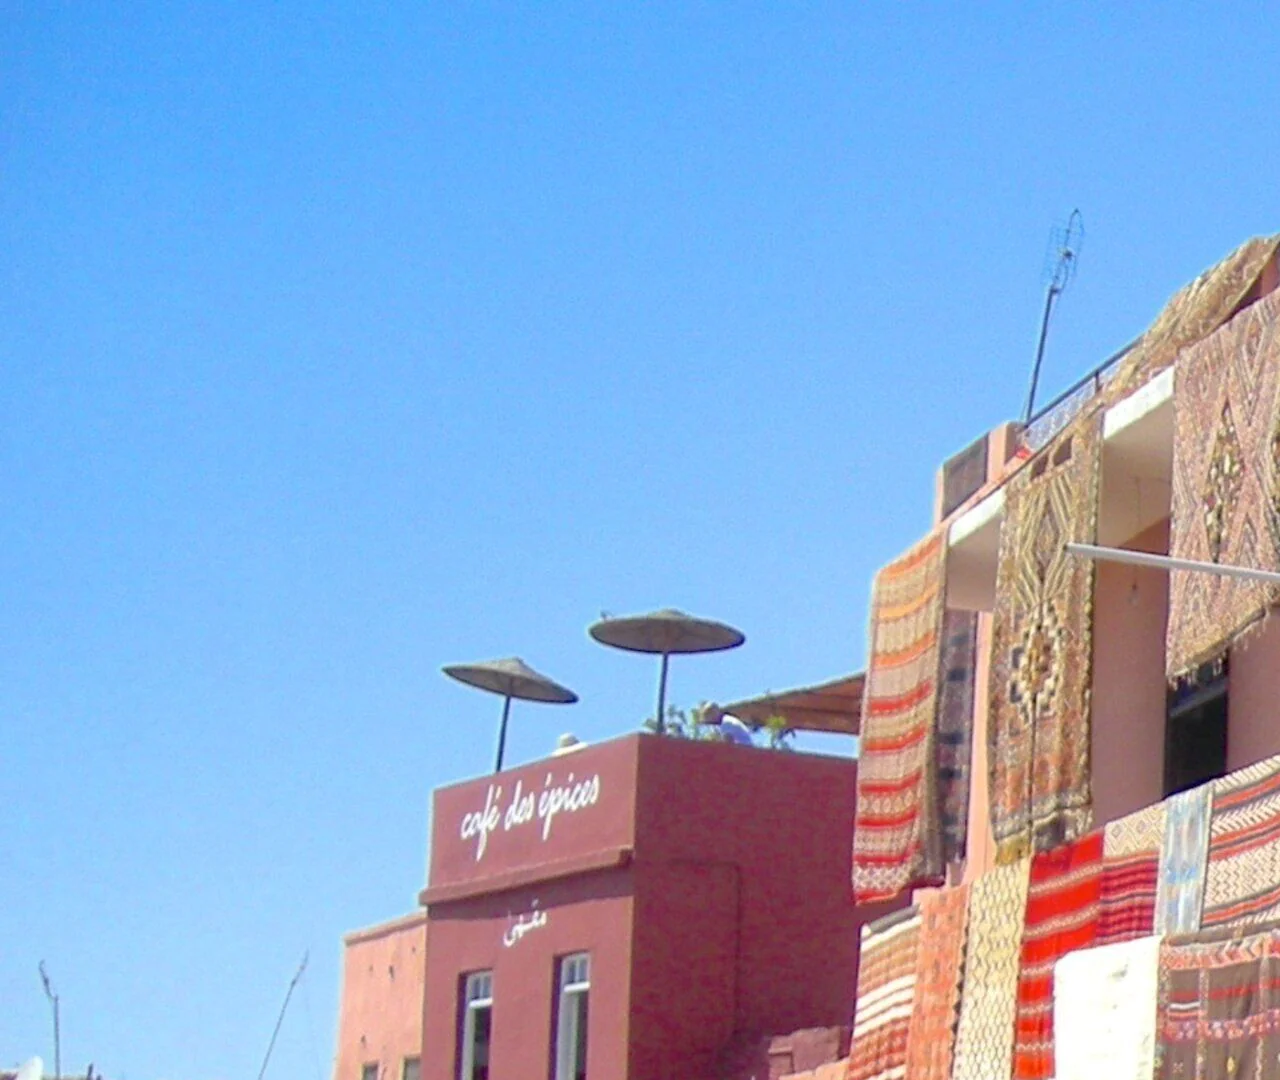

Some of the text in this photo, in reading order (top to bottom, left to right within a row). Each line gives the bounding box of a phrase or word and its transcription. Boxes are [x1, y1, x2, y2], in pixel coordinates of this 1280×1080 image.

[461, 772, 600, 862] café des épices
